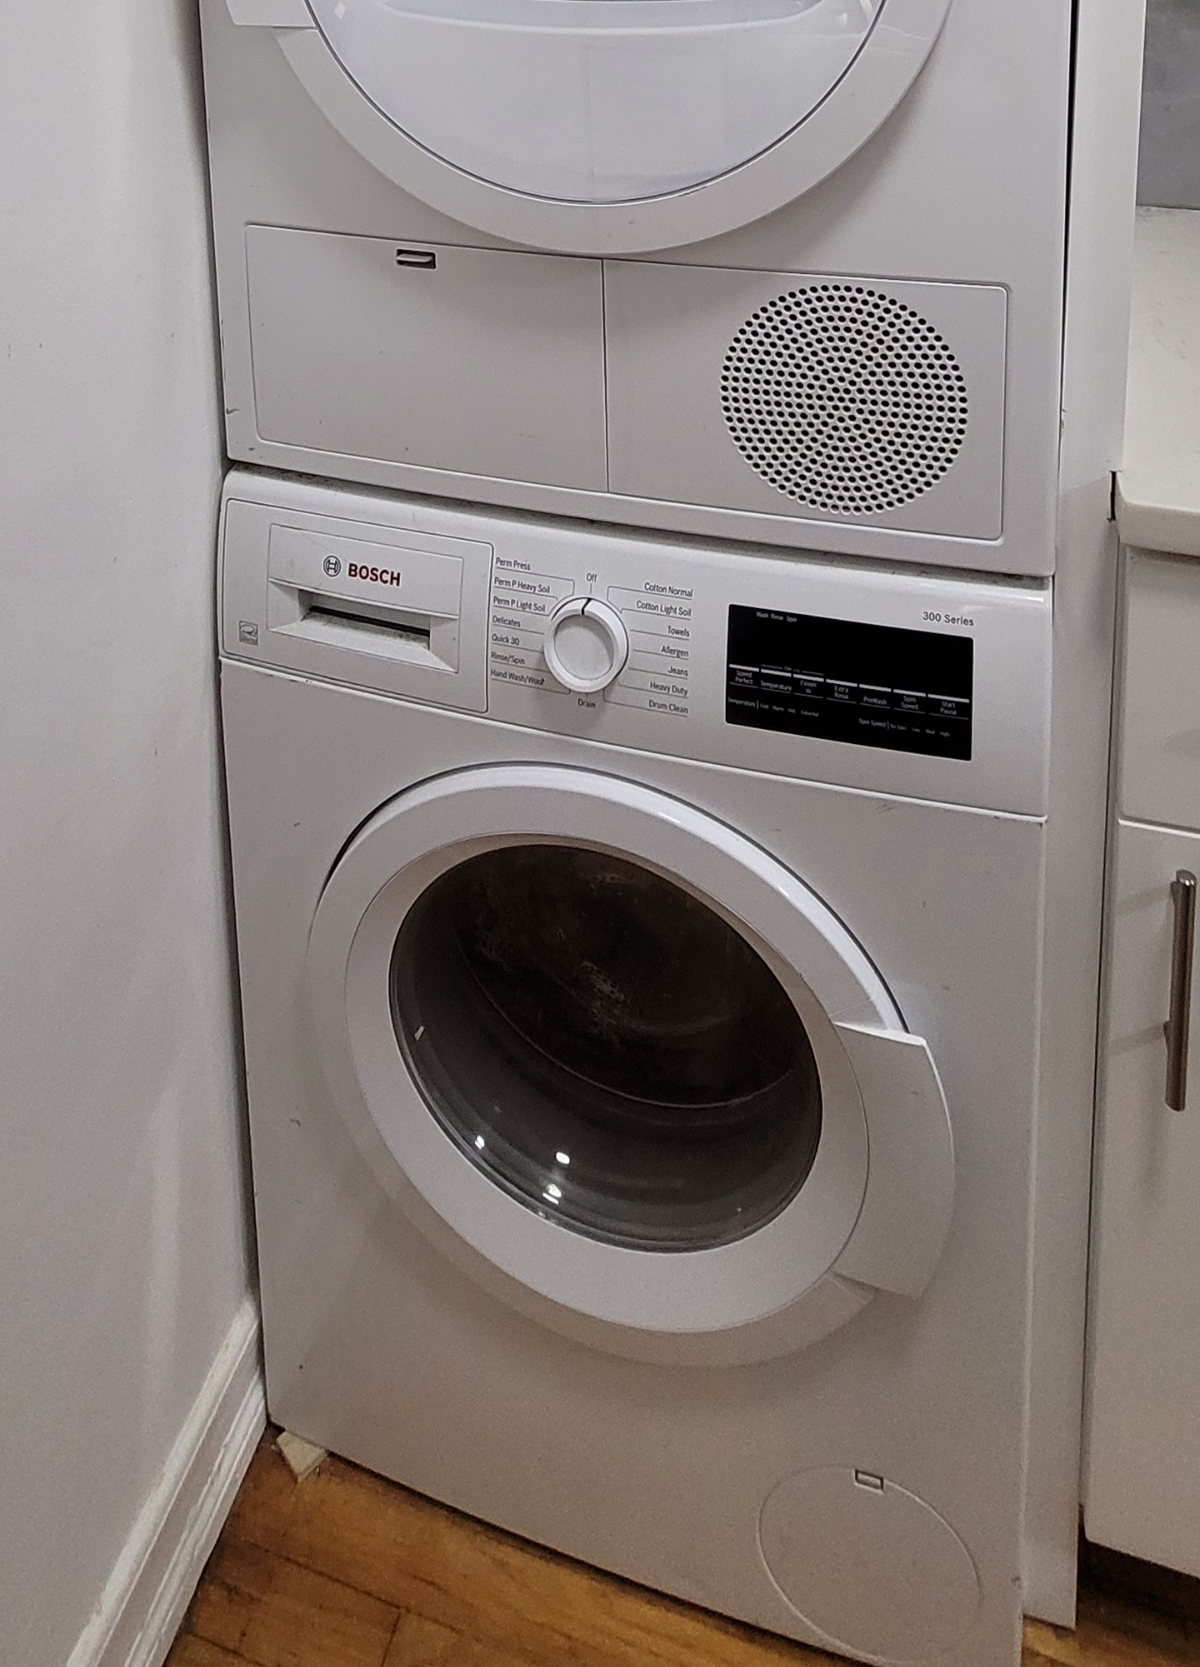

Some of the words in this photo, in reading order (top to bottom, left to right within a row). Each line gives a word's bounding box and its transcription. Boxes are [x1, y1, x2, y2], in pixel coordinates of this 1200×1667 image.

[496, 557, 512, 567] Perm
[513, 560, 531, 570] Press
[348, 563, 401, 586] BOSCH
[586, 573, 598, 582] Off
[494, 576, 511, 587] Perm
[518, 581, 537, 593] Heavy
[537, 584, 550, 593] Soil
[644, 582, 667, 593] Cotton
[668, 586, 693, 597] Normal
[493, 596, 509, 605] Perm
[516, 600, 532, 611] Light
[533, 603, 546, 613] Soil
[636, 600, 659, 611] Cotton
[660, 604, 677, 615] Light
[678, 606, 691, 616] Soil
[492, 615, 520, 627] Delicates
[922, 611, 942, 623] 300
[944, 614, 974, 627] Series
[667, 625, 690, 637] Towels
[491, 634, 509, 643] Quick
[511, 637, 520, 645] 30
[491, 651, 525, 665] Rinse/Spin
[661, 645, 689, 658] Allergen
[491, 669, 507, 679] Hand
[668, 666, 688, 676] Jeans
[650, 681, 670, 693] Heavy
[672, 685, 688, 697] Duty
[577, 698, 596, 708] Drain
[649, 699, 667, 710] Drum
[669, 703, 689, 714] Clean
